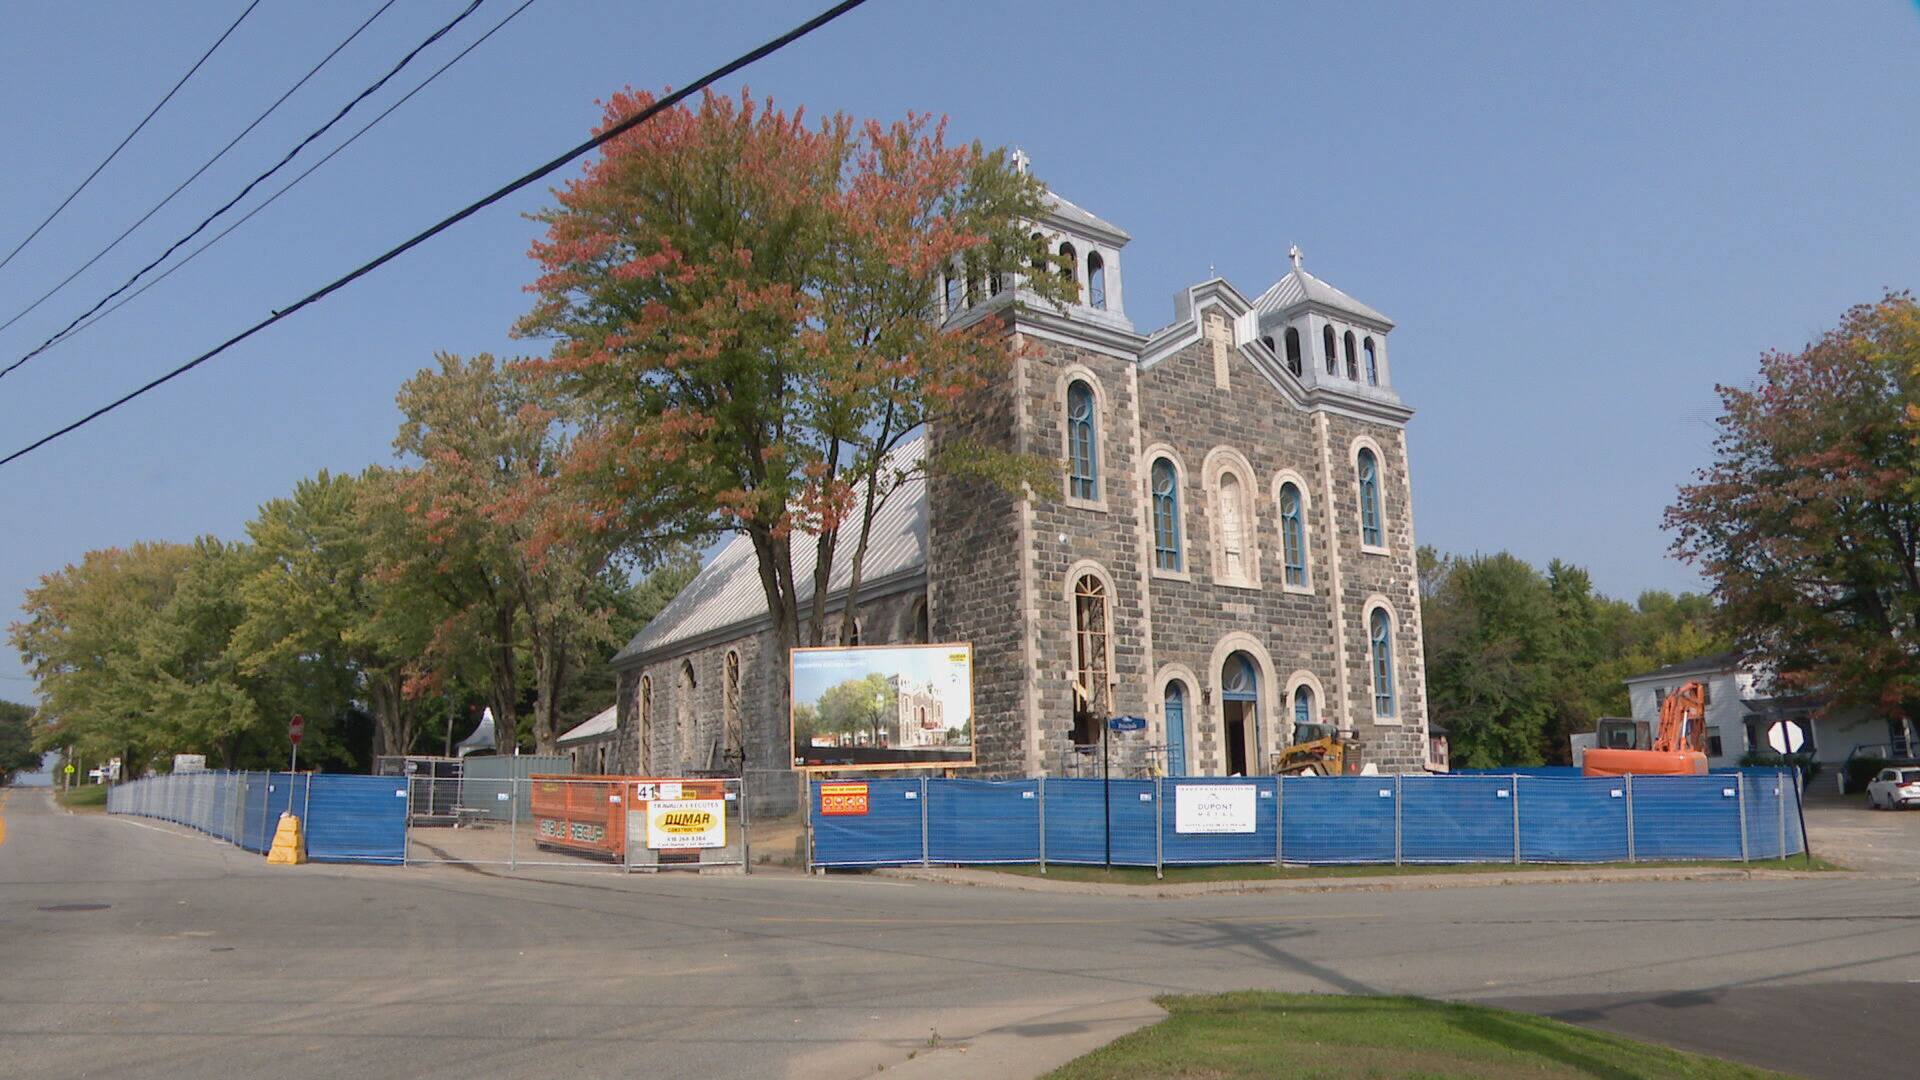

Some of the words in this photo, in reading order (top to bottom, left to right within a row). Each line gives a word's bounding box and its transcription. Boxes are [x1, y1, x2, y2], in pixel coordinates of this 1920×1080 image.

[638, 786, 655, 798] 41
[1198, 803, 1232, 811] DUPONT
[664, 813, 711, 826] DUMAR
